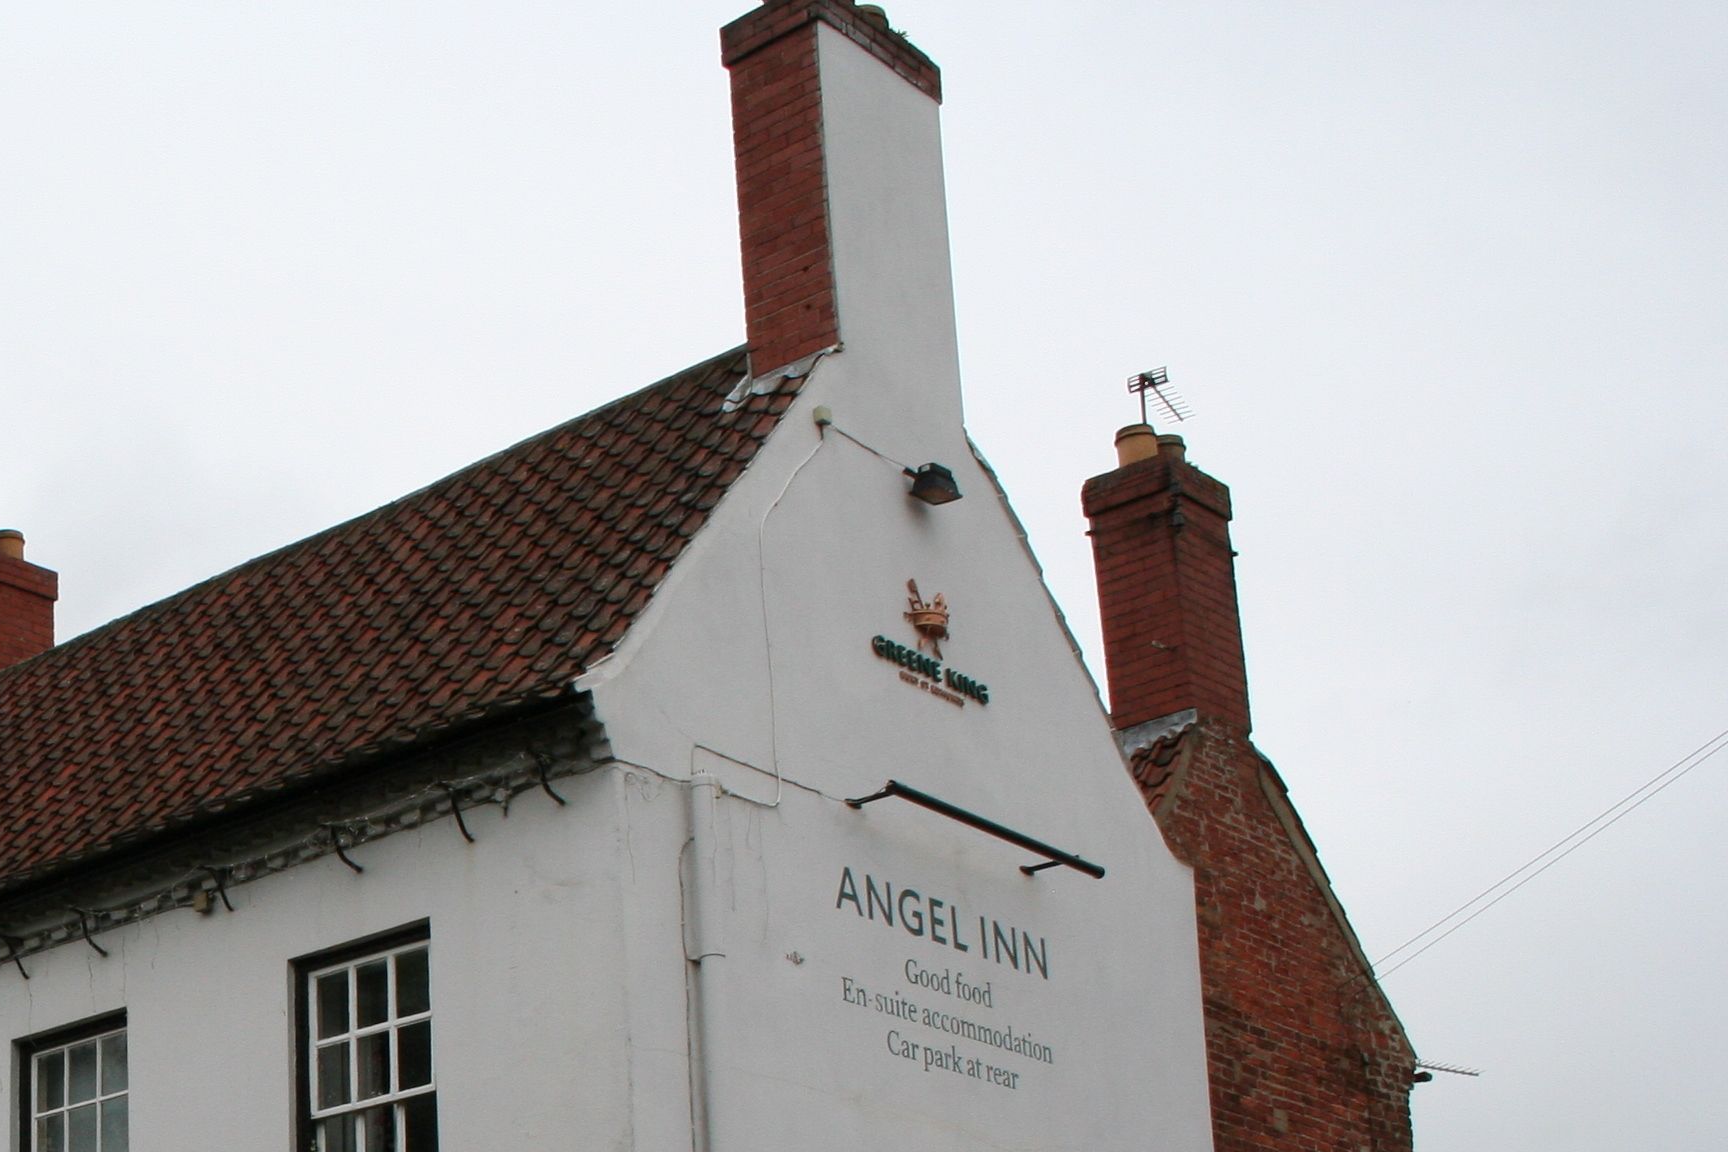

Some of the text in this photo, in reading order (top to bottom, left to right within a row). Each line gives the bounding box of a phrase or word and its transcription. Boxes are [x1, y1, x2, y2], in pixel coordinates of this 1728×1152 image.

[836, 866, 1049, 981] ANGEL INN
[841, 976, 1054, 1064] En-suite accommodation
[905, 958, 993, 1008] Good food
[887, 1030, 1020, 1090] Car park at rear
